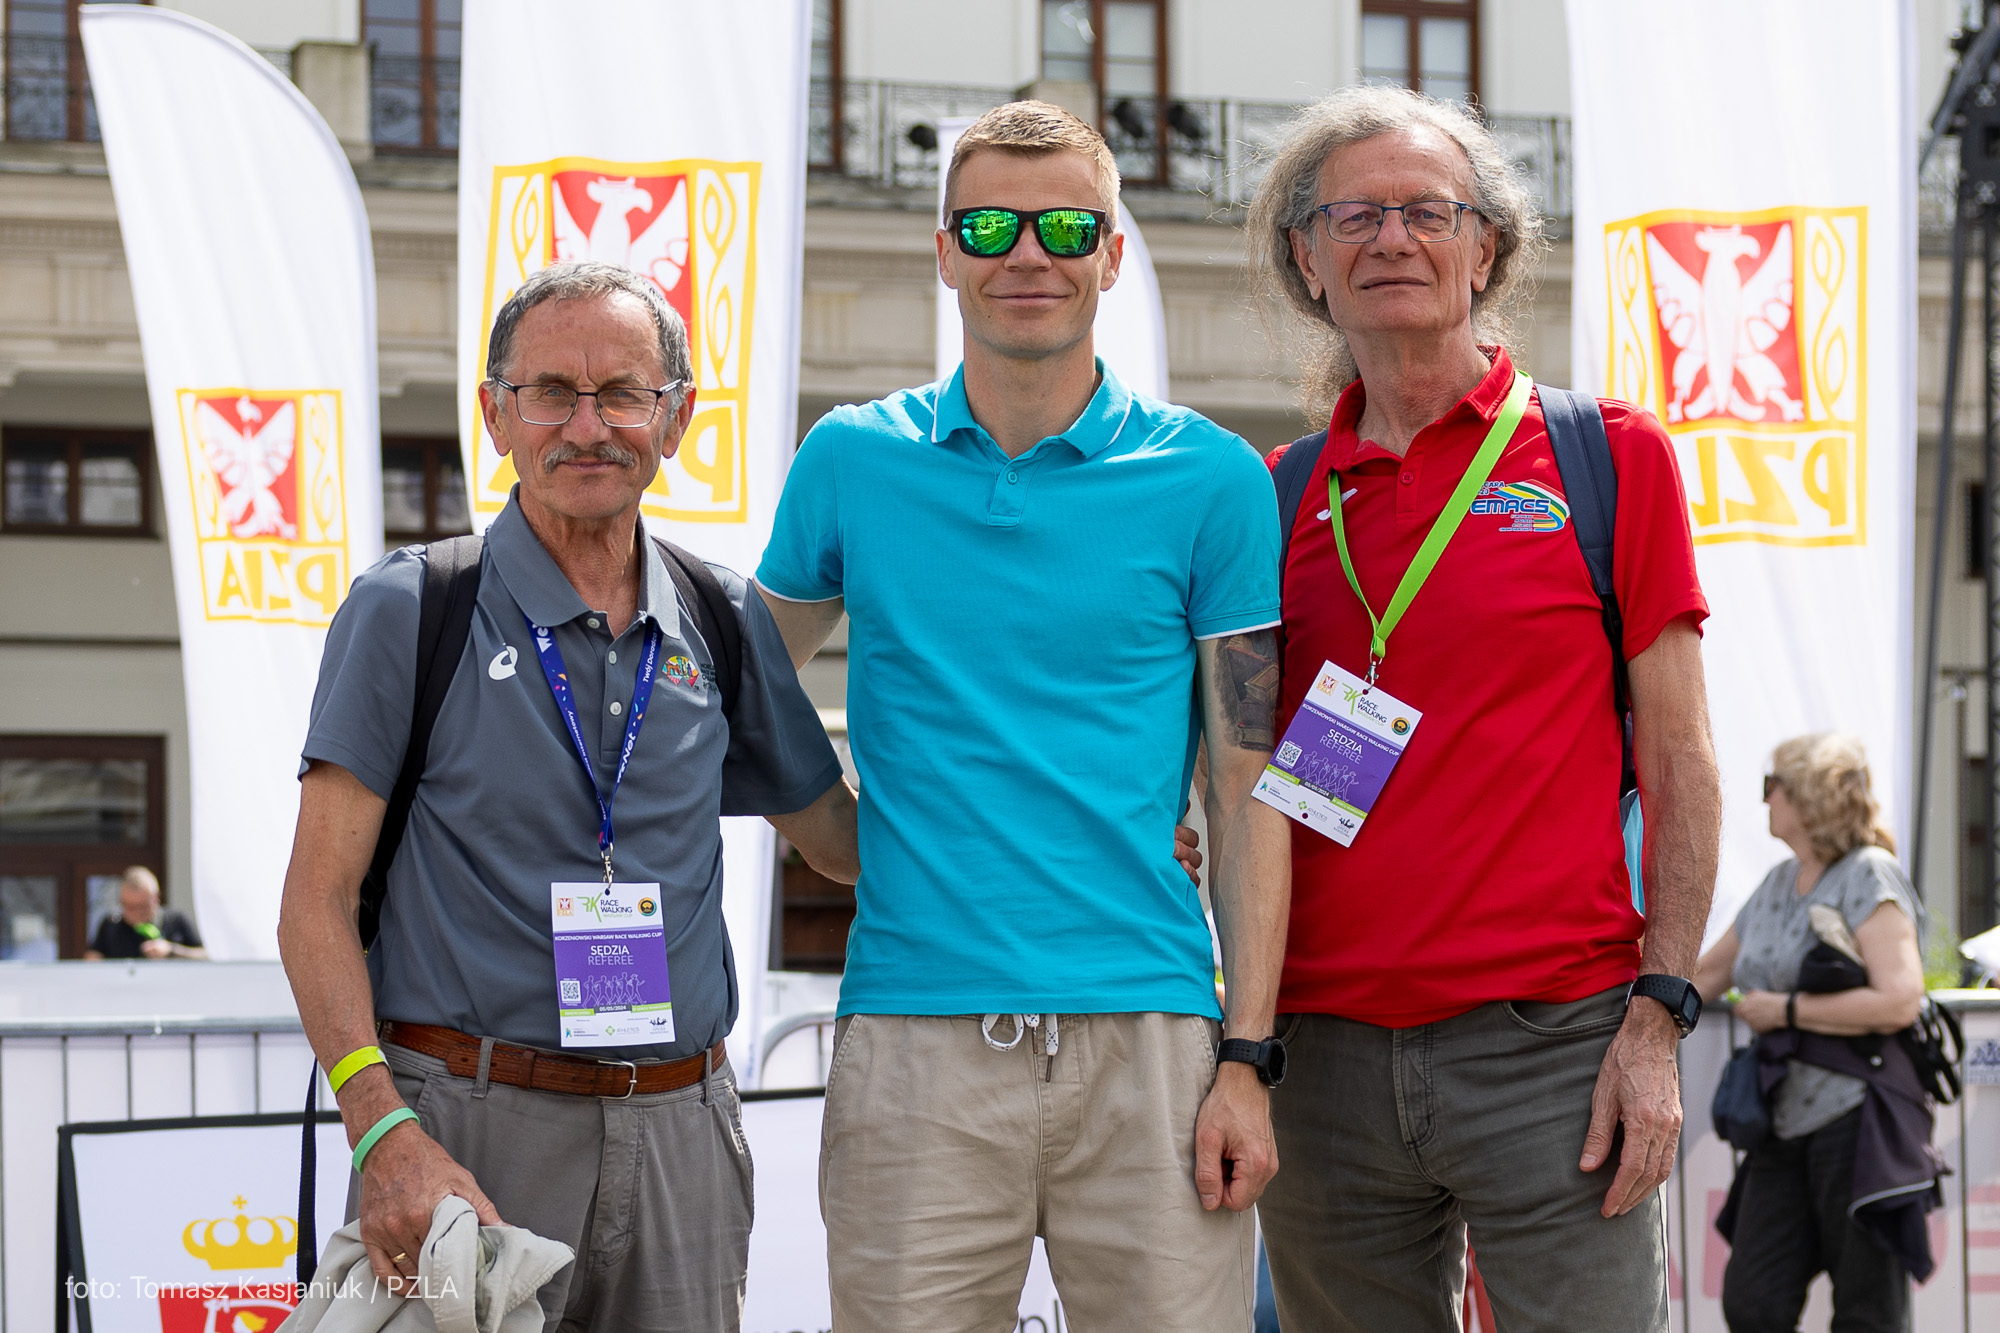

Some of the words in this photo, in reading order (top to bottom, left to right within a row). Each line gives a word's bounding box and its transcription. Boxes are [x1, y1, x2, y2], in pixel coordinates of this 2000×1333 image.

[1470, 499, 1551, 514] EMACS
[647, 632, 658, 665] Doradca
[643, 663, 654, 682] Twój
[1357, 703, 1387, 723] WALKING
[1359, 697, 1378, 711] RACE
[1327, 728, 1363, 754] SĘDZIA
[1336, 720, 1357, 735] WARSAW
[1356, 730, 1369, 741] RACE
[1368, 737, 1390, 752] WALKING
[1389, 747, 1400, 757] CUP
[1320, 735, 1364, 764] REFEREE
[588, 955, 634, 965] REFEREE
[590, 945, 630, 957] SĘDZIA
